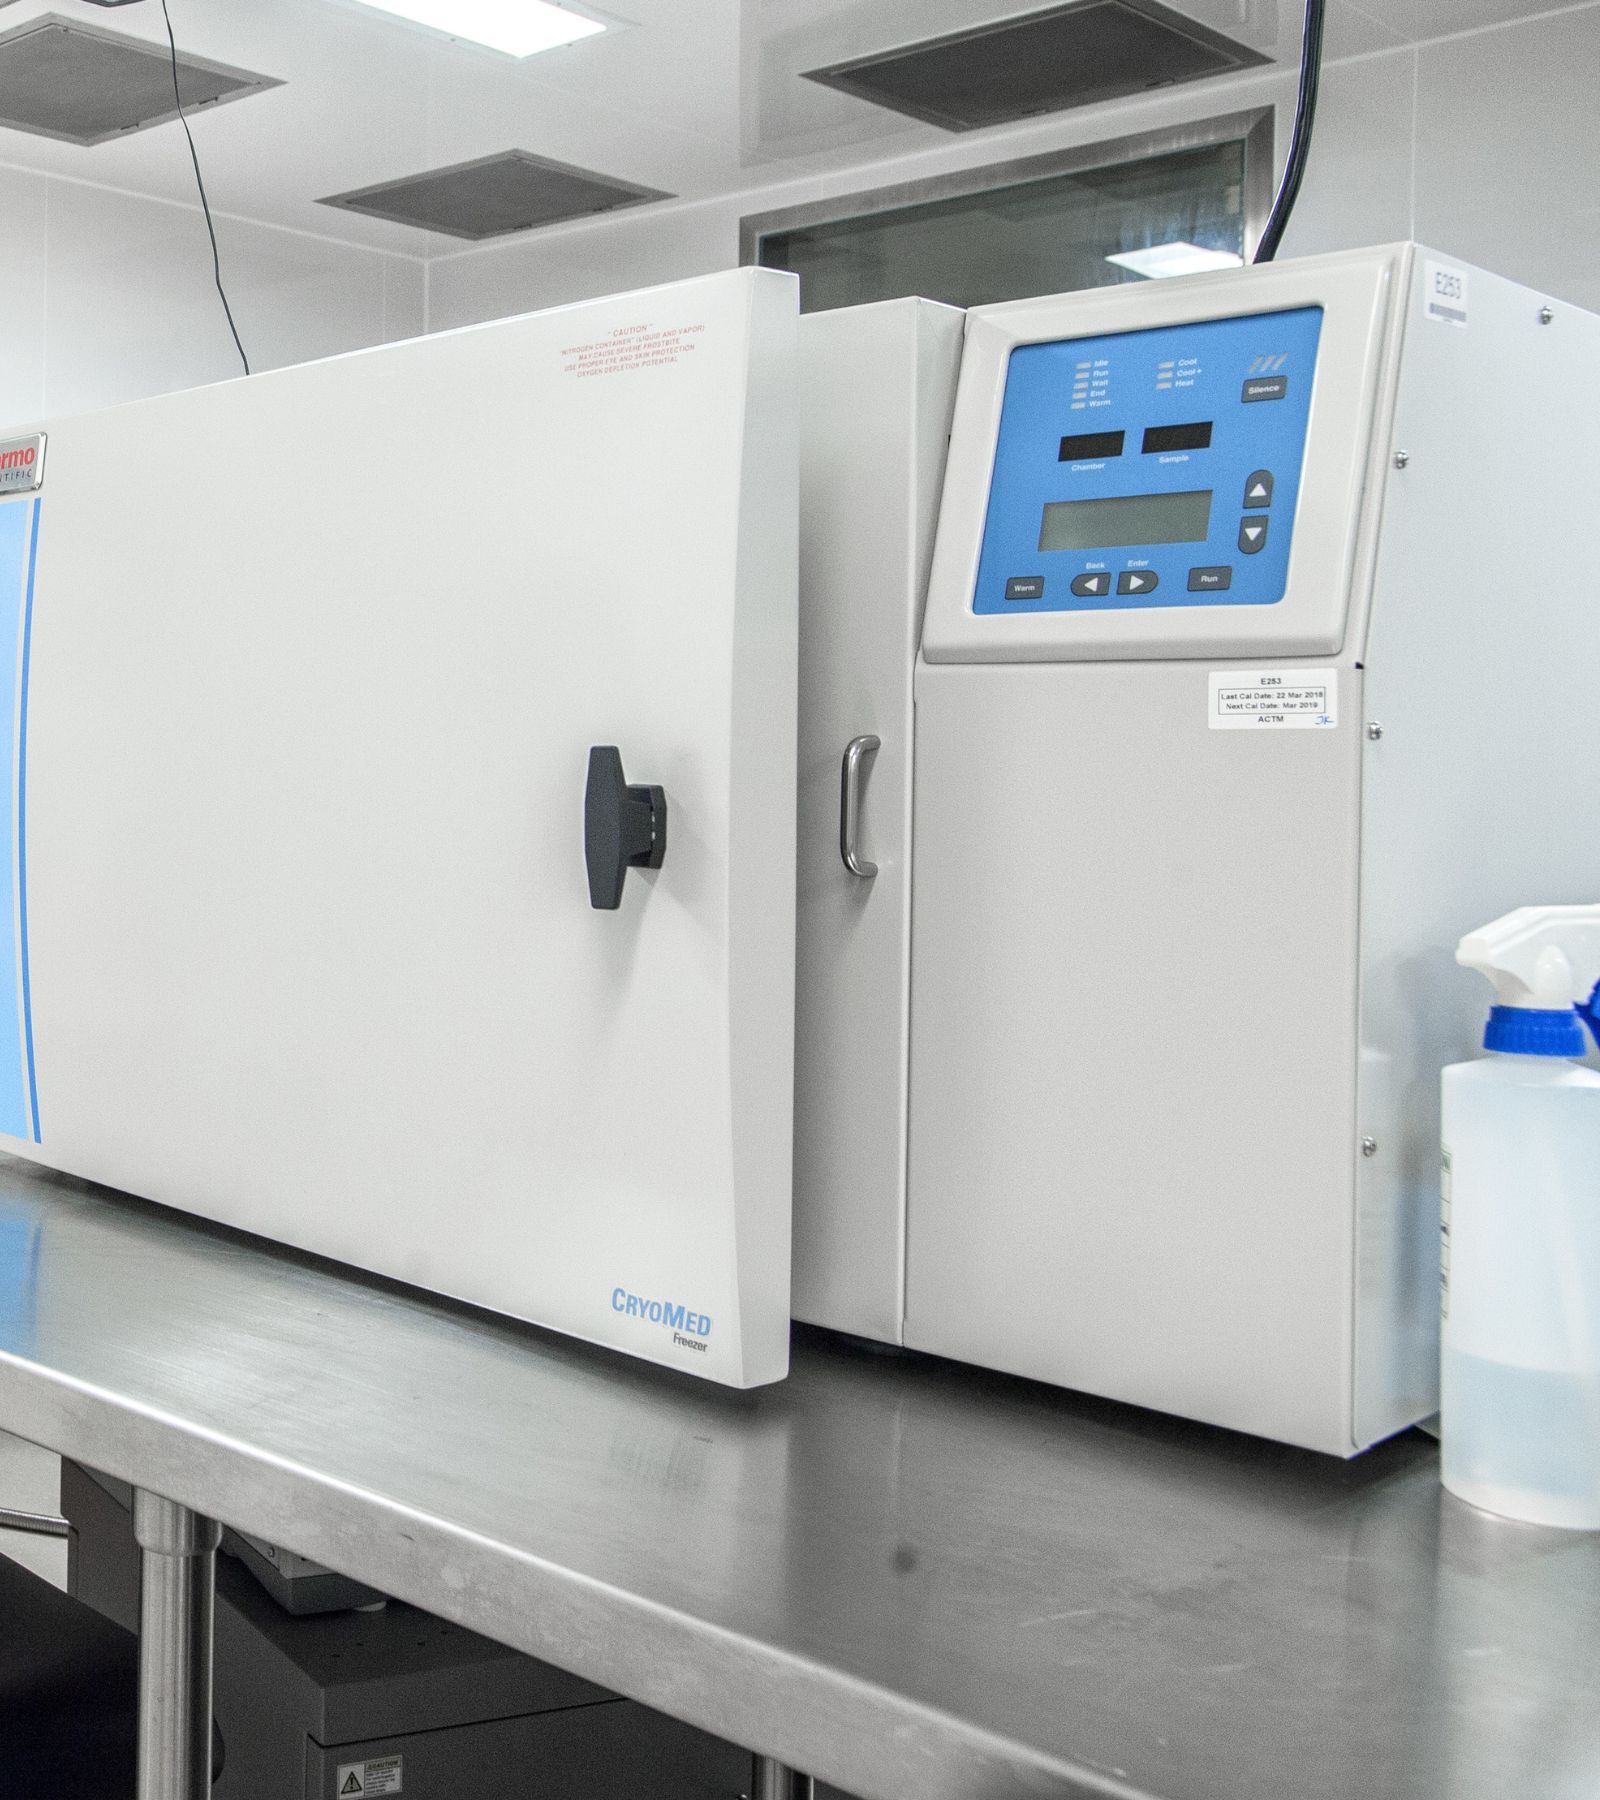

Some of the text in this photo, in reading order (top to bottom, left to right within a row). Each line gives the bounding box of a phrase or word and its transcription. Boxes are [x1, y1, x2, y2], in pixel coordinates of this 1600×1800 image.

[613, 325, 648, 337] CAUTION
[662, 330, 677, 338] AND
[578, 353, 592, 361] MAY
[594, 349, 615, 359] CAUSE
[643, 338, 680, 350] FROSTBITE
[619, 354, 633, 363] AND
[652, 344, 695, 357] PROTECTION
[1178, 358, 1197, 367] Cool
[1175, 379, 1194, 388] Heat
[1090, 389, 1106, 397] End
[1248, 385, 1279, 394] Silence
[1089, 399, 1111, 407] Warm
[1159, 454, 1189, 464] Sample
[1071, 462, 1105, 472] Chamber
[1086, 561, 1105, 569] Back
[1127, 559, 1149, 567] Enter
[1201, 574, 1218, 583] Run
[1014, 584, 1035, 592] Warm
[673, 1332, 708, 1352] Freezer
